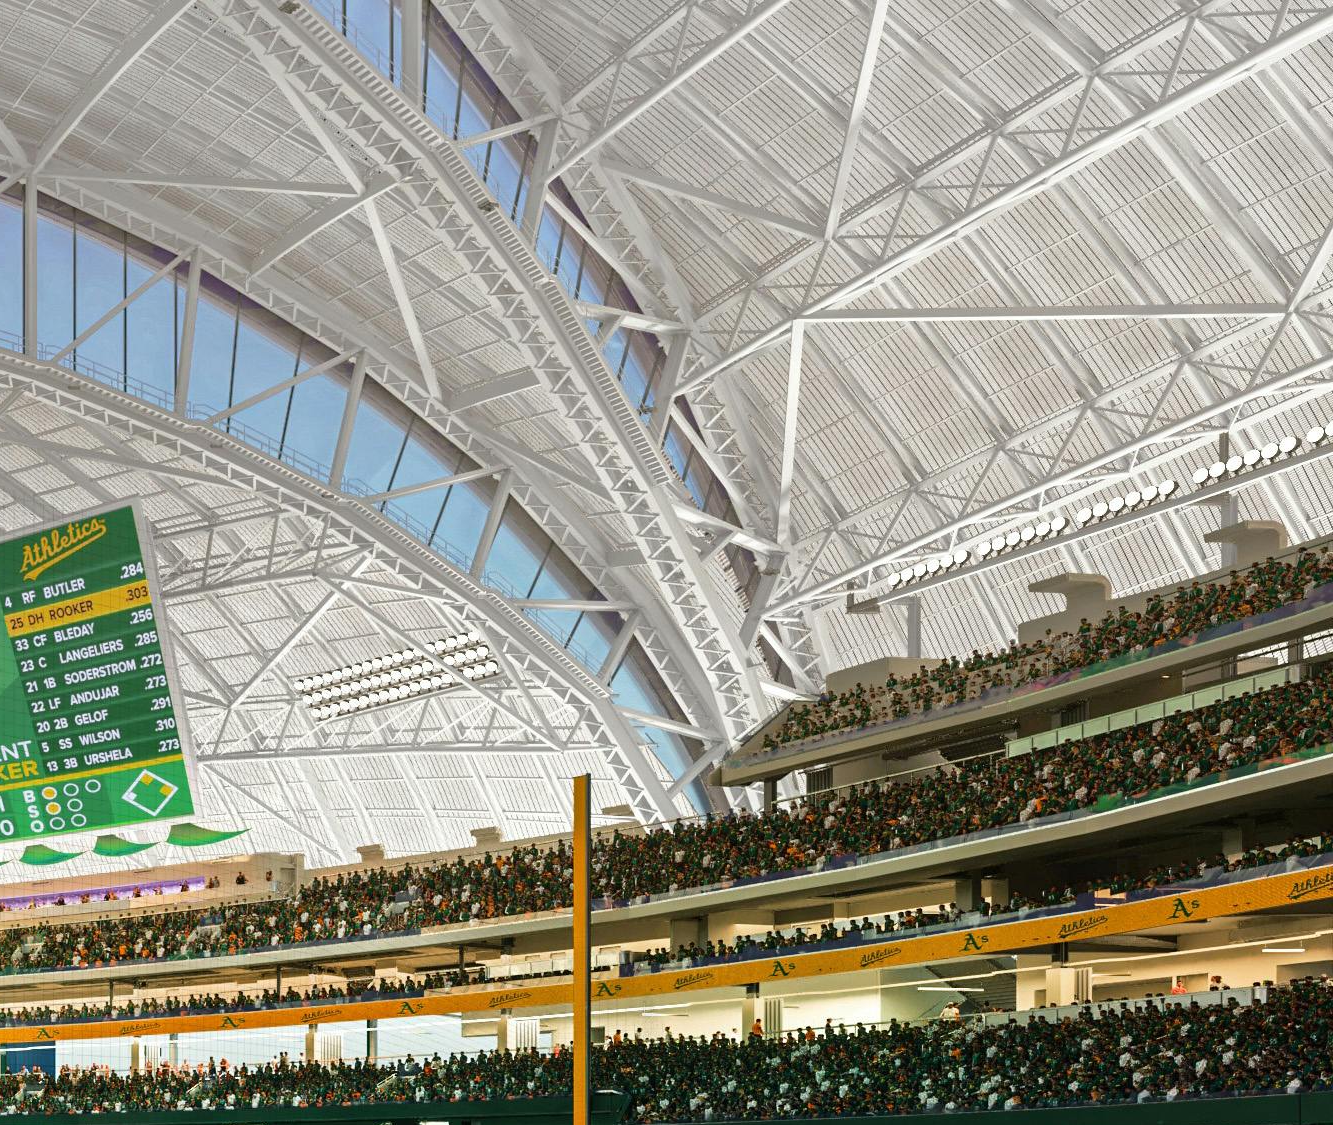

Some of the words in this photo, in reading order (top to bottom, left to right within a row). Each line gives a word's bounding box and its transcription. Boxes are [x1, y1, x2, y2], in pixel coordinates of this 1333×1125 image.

[19, 518, 107, 581] Athletics
[4, 596, 12, 607] 4
[21, 590, 35, 604] RF
[43, 577, 85, 598] BUTLER
[120, 561, 143, 579] .284
[10, 617, 23, 630] 25
[27, 612, 44, 625] DH
[48, 600, 93, 620] ROOKER
[125, 585, 148, 601] .303
[15, 638, 29, 651] 33
[33, 634, 47, 647] CF
[53, 622, 93, 642] BLEDAY
[130, 608, 153, 624] .256
[20, 659, 34, 672] 23
[38, 656, 47, 668] C
[59, 639, 123, 663] LANGELIERS
[134, 630, 157, 646] .285
[25, 680, 38, 692] 21
[43, 677, 56, 688] 1B
[64, 658, 136, 684] SODERSTROM
[140, 653, 162, 668] .272
[31, 700, 45, 713] 22
[48, 697, 61, 709] LF
[70, 685, 119, 705] ANDUJAR
[145, 674, 166, 689] .273
[36, 721, 50, 733] 20
[53, 717, 68, 729] 2B
[74, 709, 108, 725] GELOF
[150, 696, 171, 710] .291
[41, 741, 49, 752] 5
[58, 737, 72, 749] SS
[78, 728, 120, 745] WILSON
[155, 717, 175, 731] .310
[46, 760, 58, 771] 13
[63, 757, 78, 769] 3B
[84, 747, 133, 765] URSHELA
[158, 738, 179, 752] .273
[22, 790, 35, 803] B
[27, 805, 39, 818] S
[0, 819, 14, 835] 0
